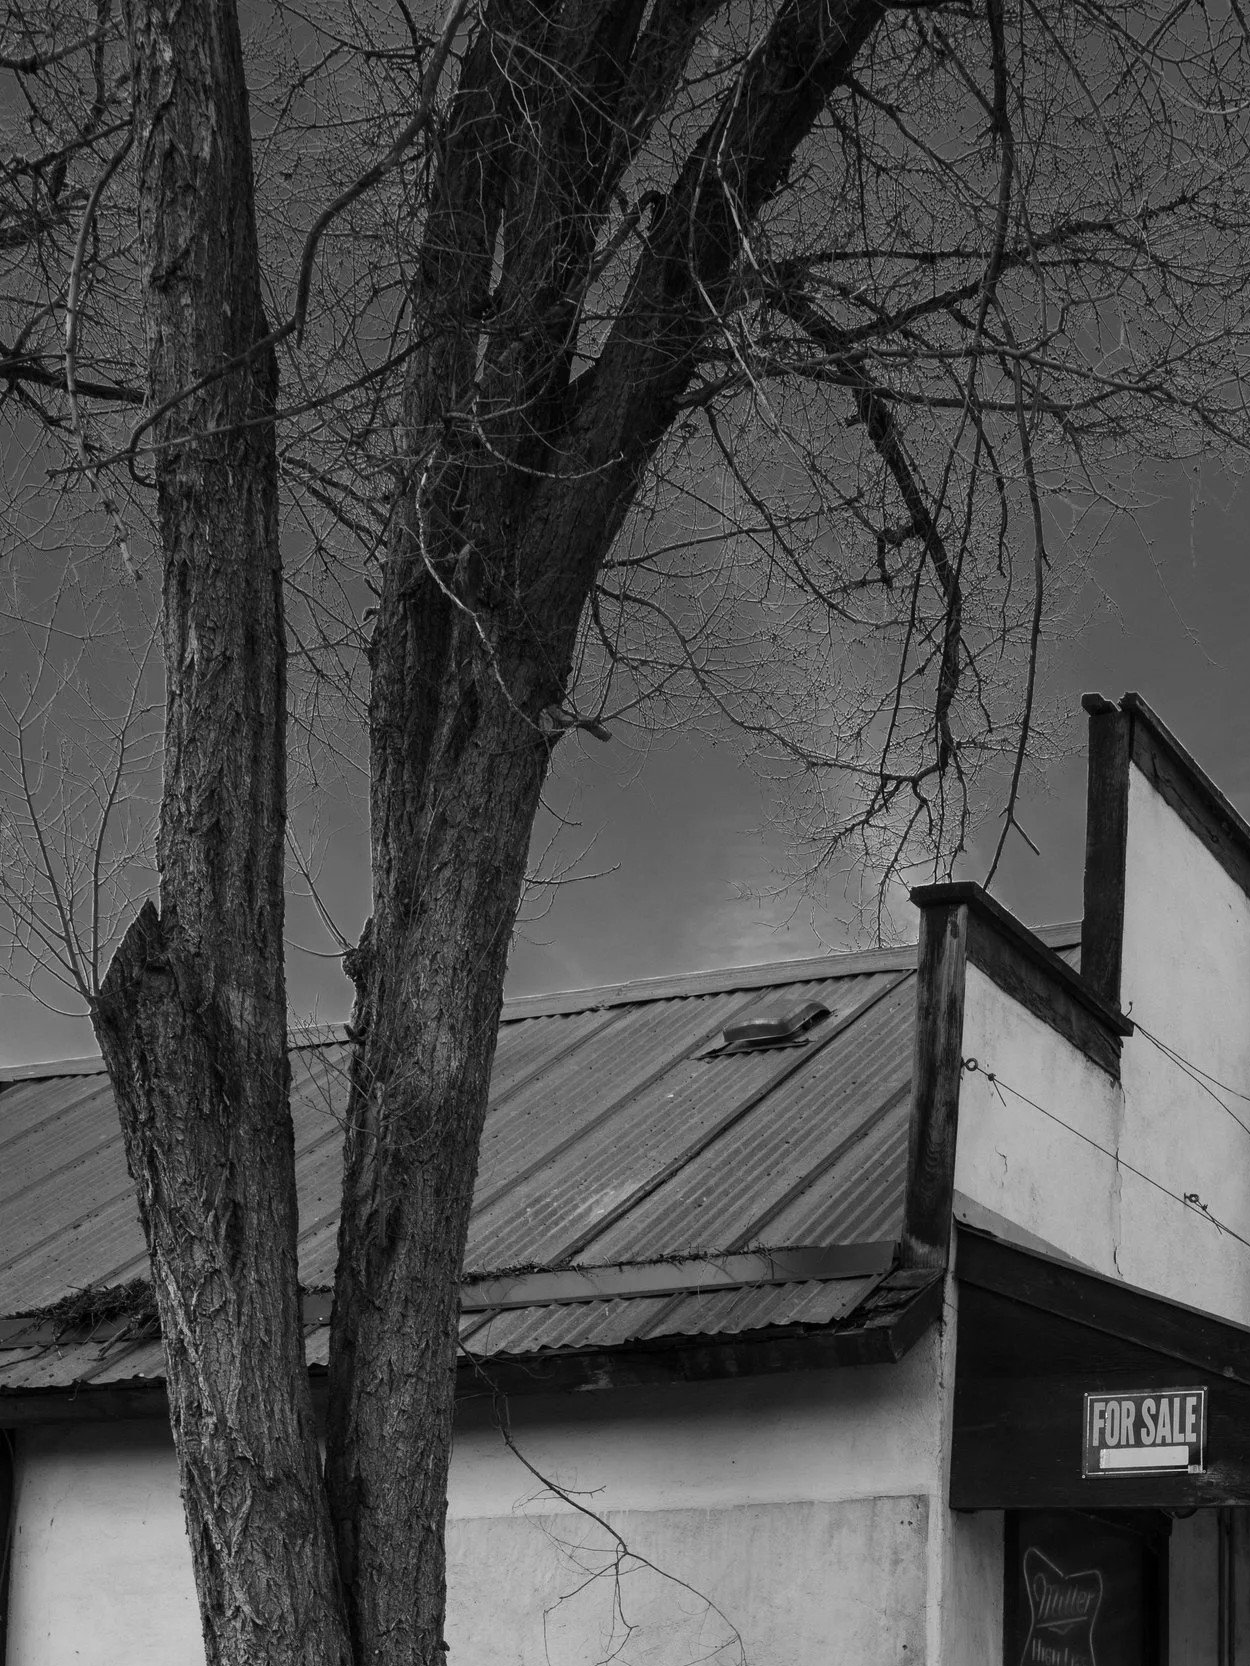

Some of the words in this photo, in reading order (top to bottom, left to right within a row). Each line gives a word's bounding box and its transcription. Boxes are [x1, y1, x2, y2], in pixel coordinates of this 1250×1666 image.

[1092, 1400, 1137, 1447] FOR
[1140, 1396, 1198, 1446] SALE
[1033, 1572, 1096, 1619] Miller
